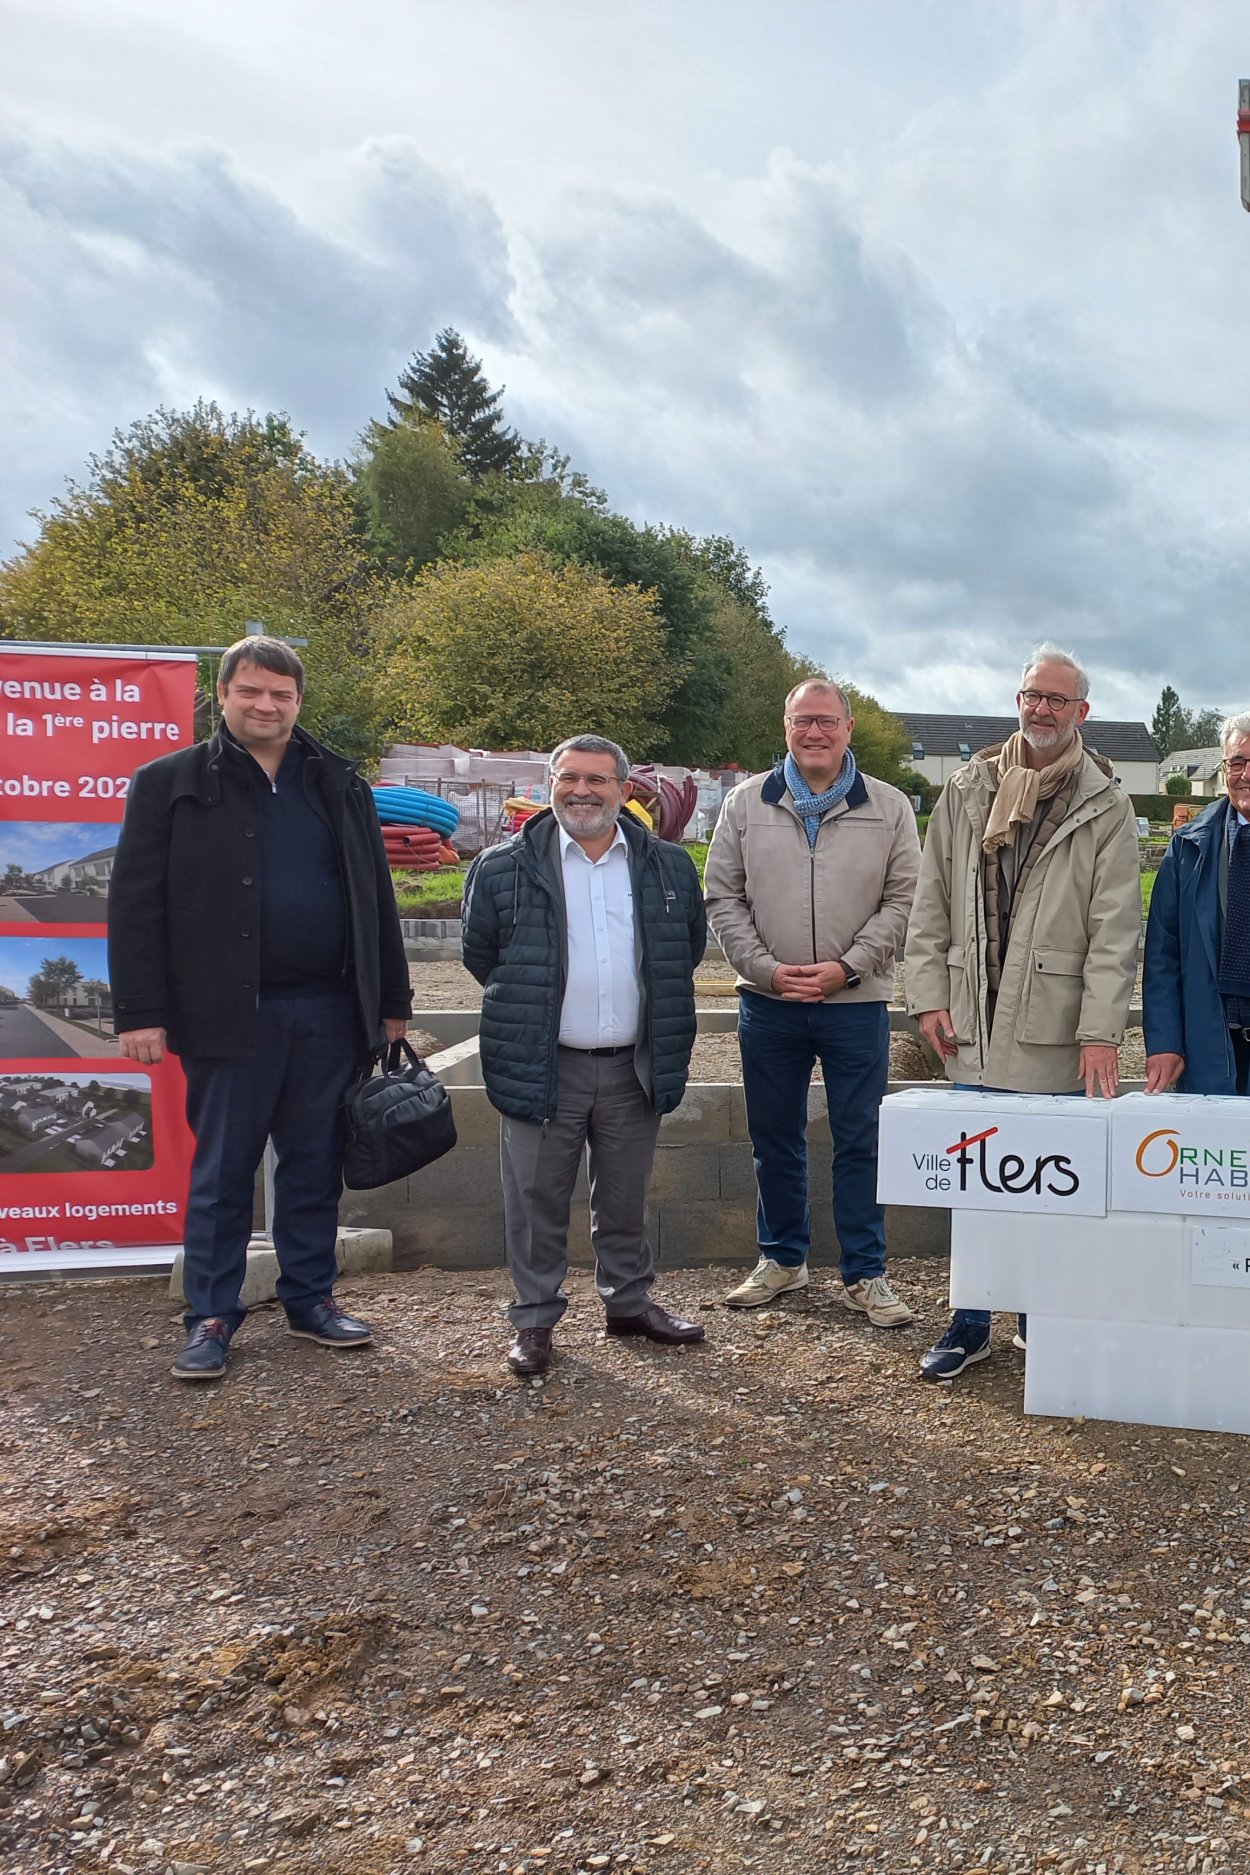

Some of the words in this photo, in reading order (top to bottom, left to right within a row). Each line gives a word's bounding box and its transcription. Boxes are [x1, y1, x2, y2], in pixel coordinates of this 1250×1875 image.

[0, 680, 81, 700] enue
[89, 678, 107, 702] à
[115, 679, 141, 702] la
[6, 712, 33, 736] la
[41, 713, 84, 737] 1ère
[92, 715, 180, 744] pierre
[0, 774, 71, 798] obre
[912, 1153, 952, 1172] Ville
[925, 1174, 951, 1191] de
[1179, 1189, 1211, 1200] Votre
[65, 1200, 178, 1221] logements
